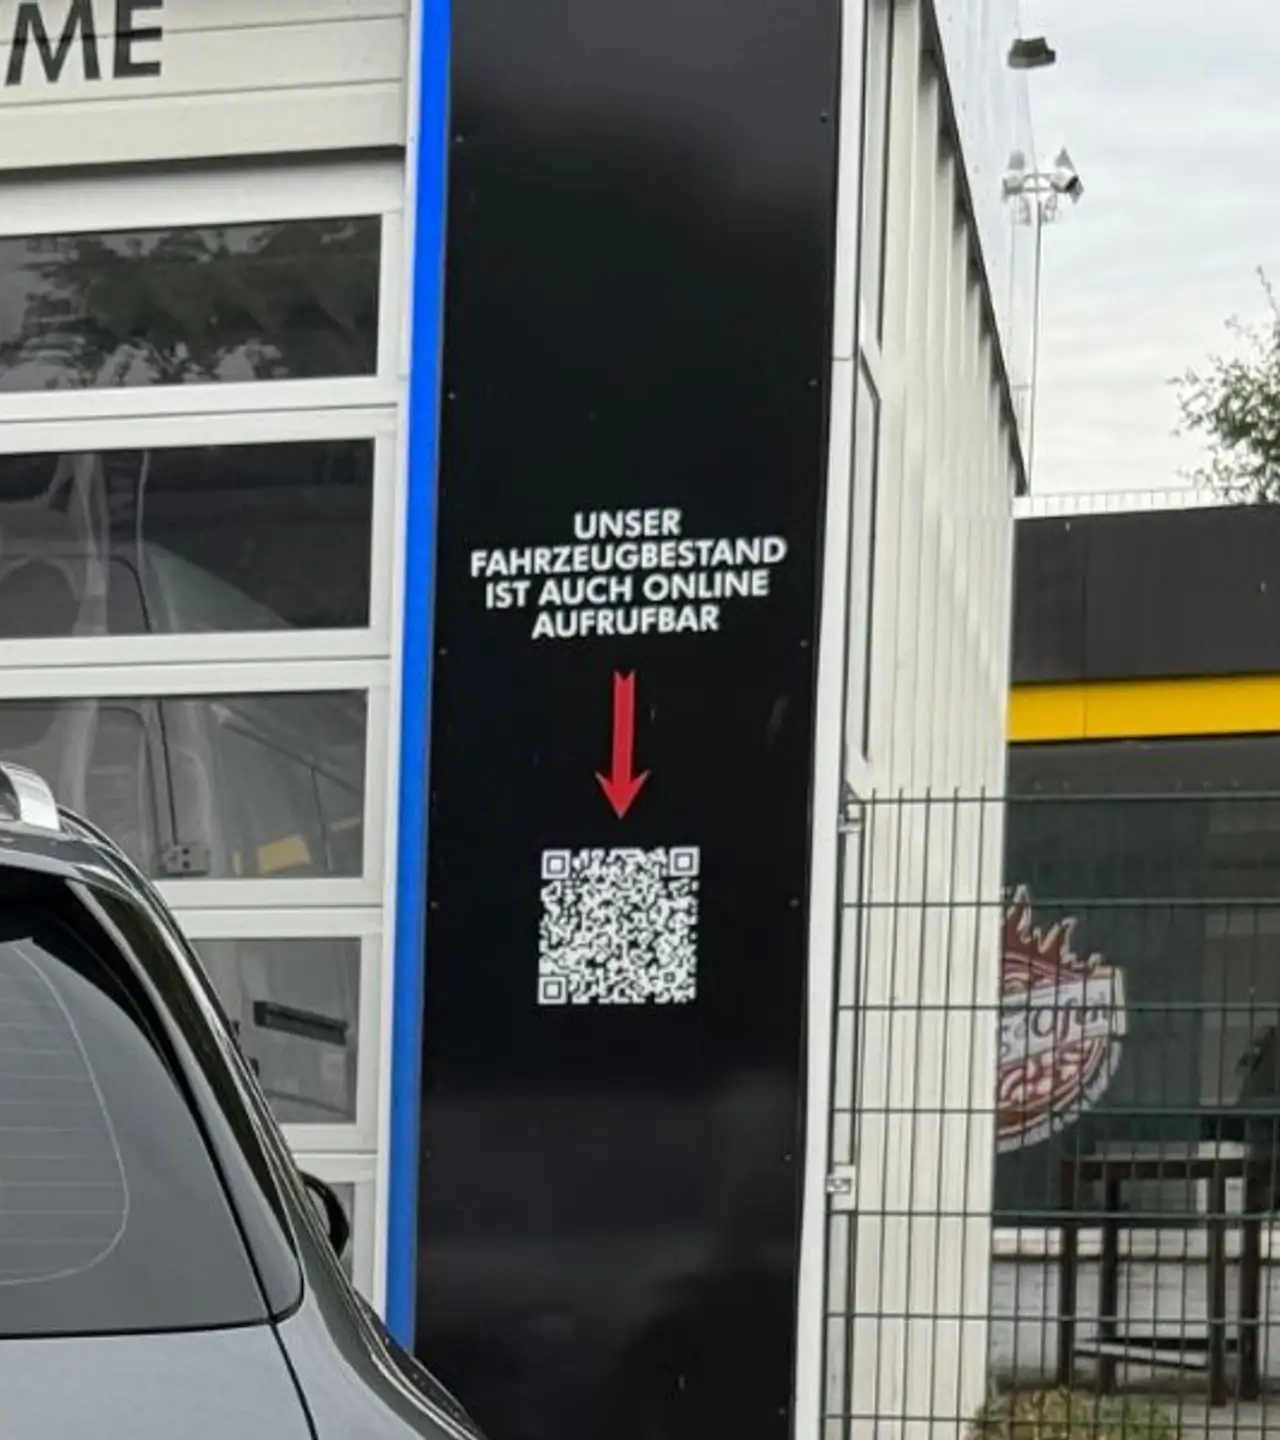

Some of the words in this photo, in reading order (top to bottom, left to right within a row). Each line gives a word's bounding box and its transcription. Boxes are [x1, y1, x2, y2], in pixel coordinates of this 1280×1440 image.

[573, 509, 683, 541] UNSER
[470, 535, 788, 578] FAHRZEUGBESTAND
[485, 582, 531, 610] IST
[538, 575, 633, 607] AUCH
[643, 568, 771, 602] ONLINE
[532, 603, 720, 640] AUFRUFBAR
